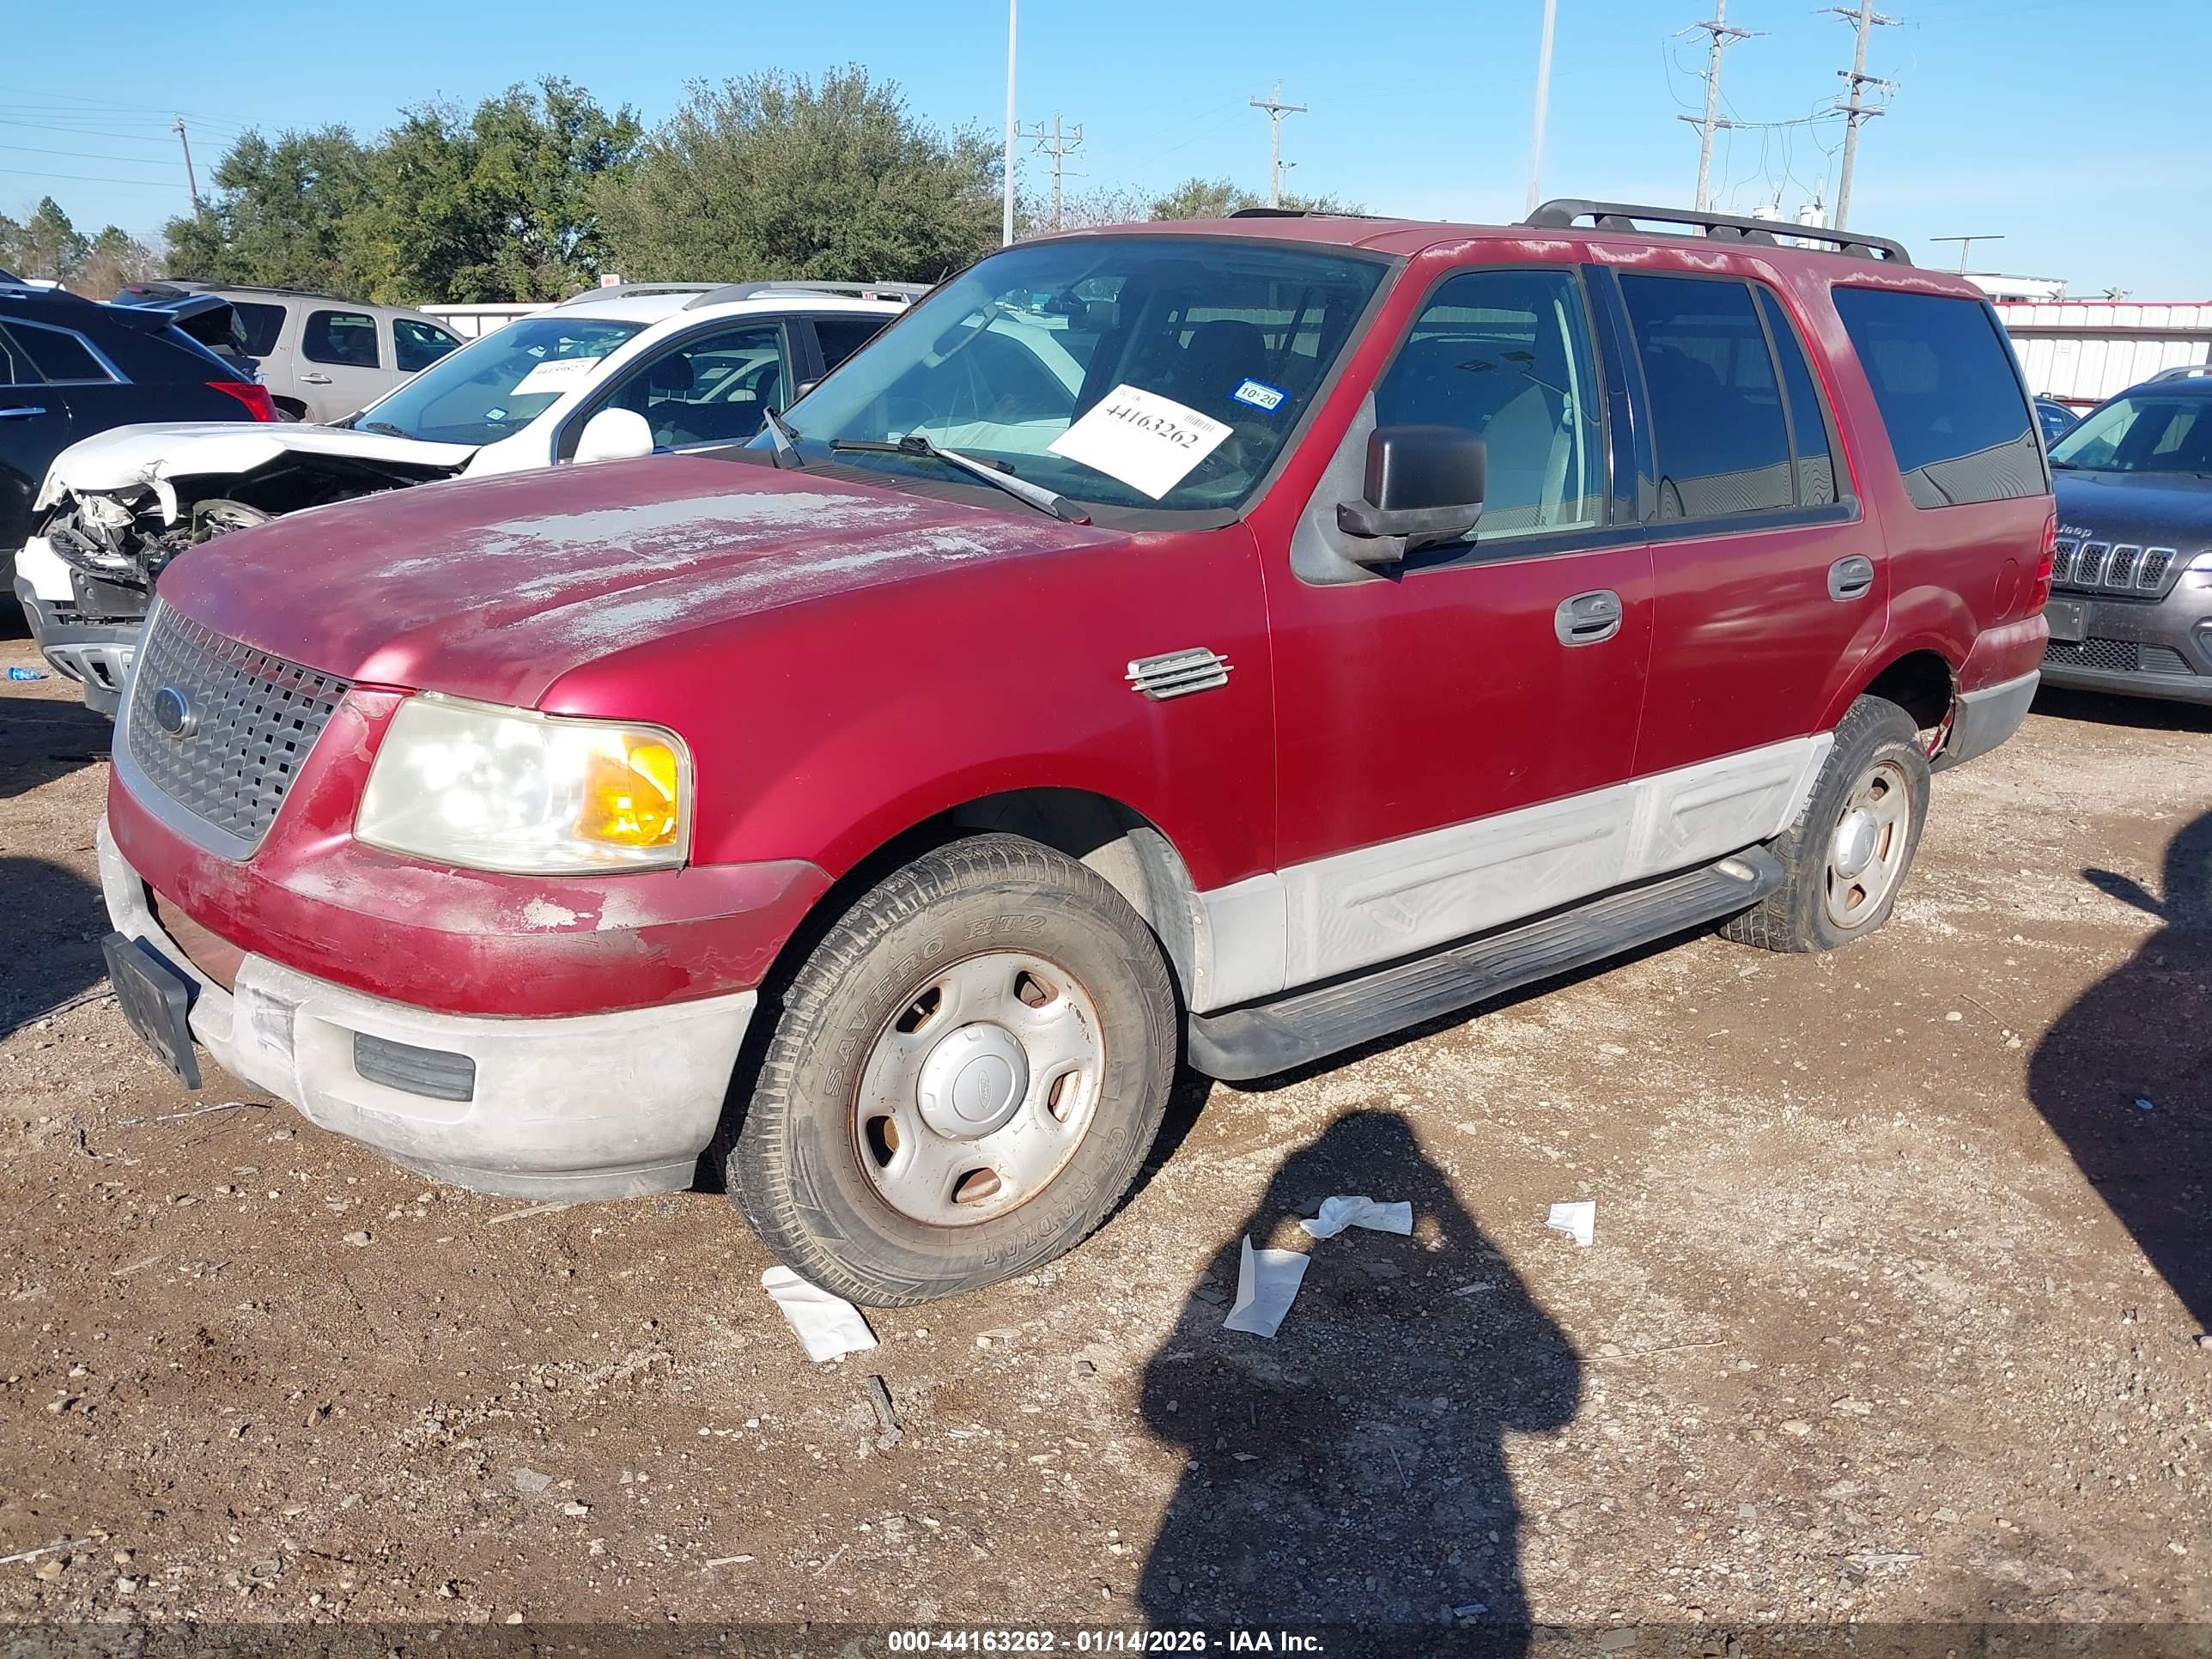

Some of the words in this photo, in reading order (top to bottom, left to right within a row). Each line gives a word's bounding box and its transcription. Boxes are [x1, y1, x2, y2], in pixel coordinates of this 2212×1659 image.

[1106, 404, 1199, 448] 44163262
[1242, 387, 1256, 398] 10
[1260, 394, 1278, 405] 20
[824, 935, 946, 1097] SAVERO
[963, 914, 1047, 941] HT2
[977, 1175, 1097, 1265] RADIAL
